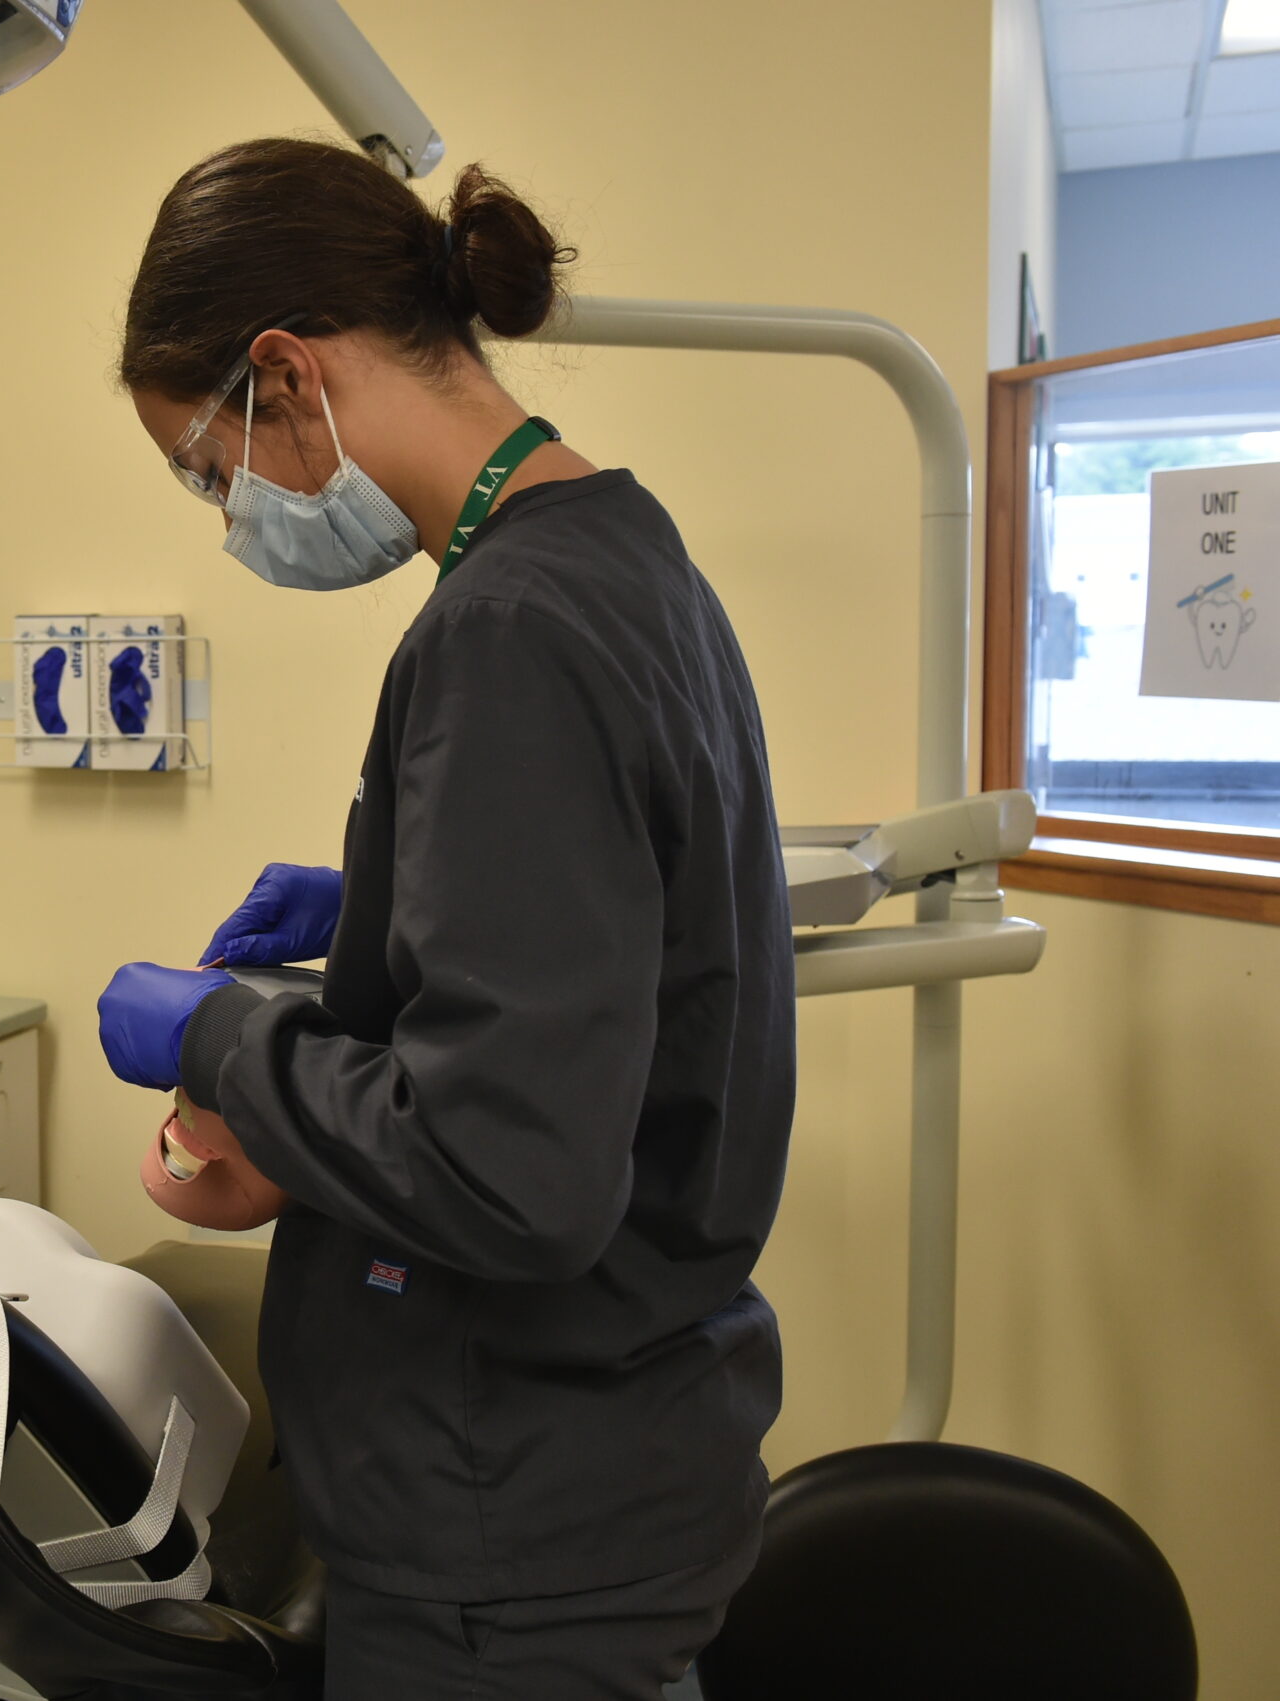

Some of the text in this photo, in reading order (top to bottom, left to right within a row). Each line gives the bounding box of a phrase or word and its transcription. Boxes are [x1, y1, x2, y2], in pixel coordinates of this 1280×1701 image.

[474, 466, 508, 500] VT
[1202, 491, 1239, 516] UNIT
[1201, 531, 1236, 555] ONE
[70, 641, 82, 679] ultra
[148, 641, 160, 679] ultra
